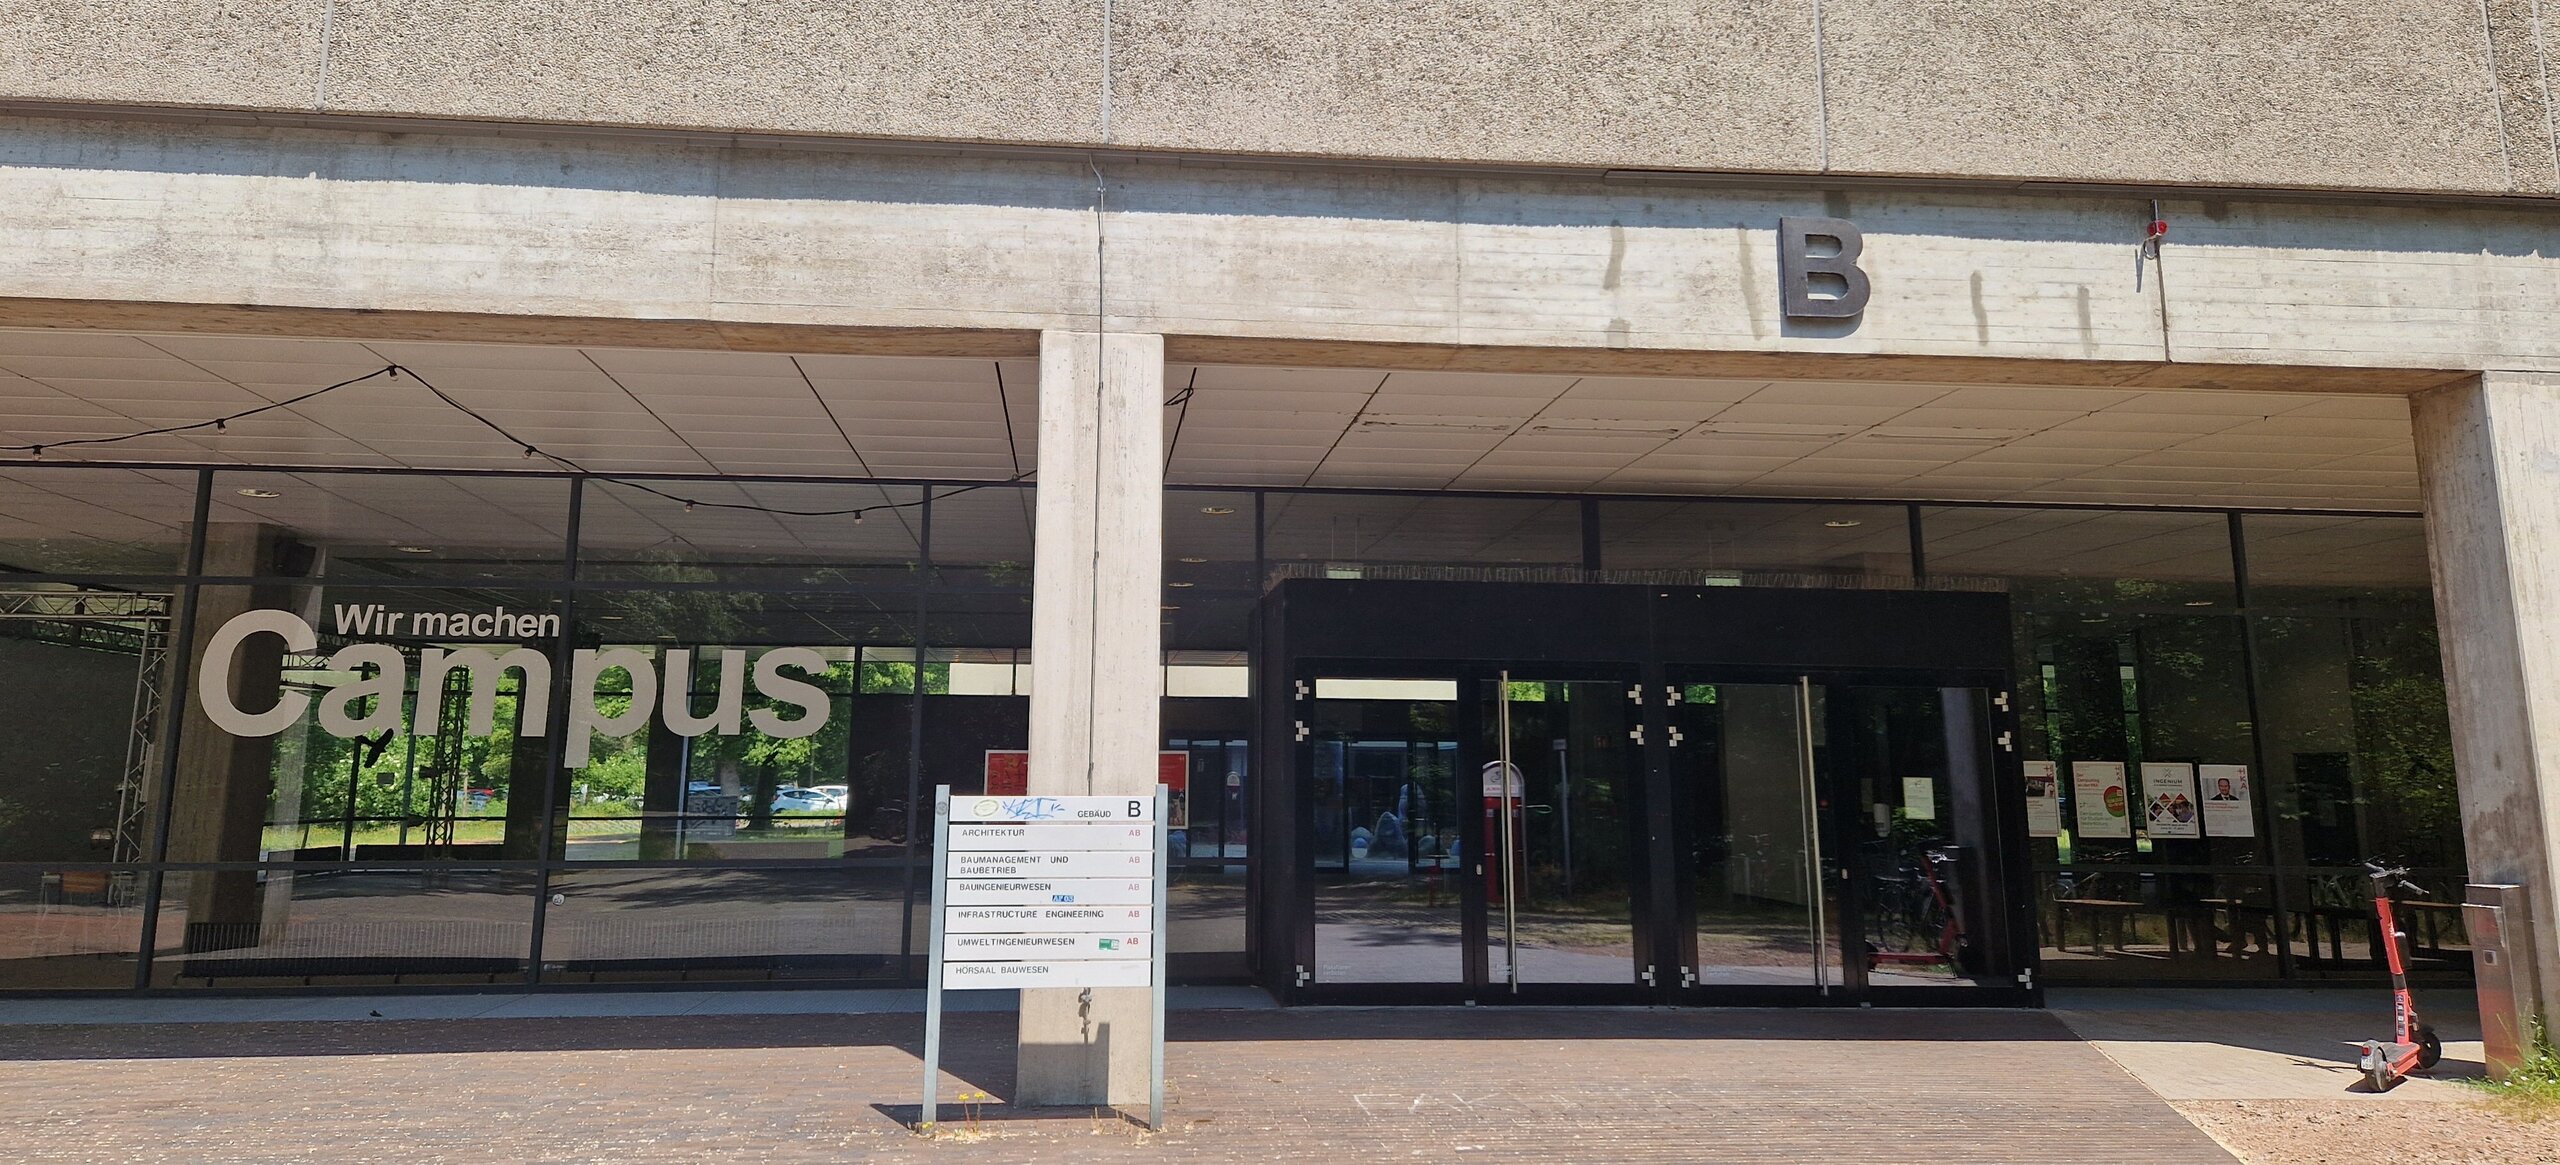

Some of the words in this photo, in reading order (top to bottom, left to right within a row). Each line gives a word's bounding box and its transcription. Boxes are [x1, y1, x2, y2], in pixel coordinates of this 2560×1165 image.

[1780, 216, 1871, 318] B
[334, 604, 403, 636] Wir
[412, 606, 560, 638] machen
[198, 609, 831, 768] Campus
[1077, 809, 1112, 818] GEBÄUD
[1127, 800, 1142, 818] B
[961, 829, 1025, 837] ARCHITEKTUR
[1128, 829, 1141, 837] AB
[960, 855, 1041, 864] BAUMANAGEMENT
[1050, 856, 1069, 864] UND
[1128, 856, 1141, 864] AB
[960, 866, 1017, 875] BAUBETRIEB
[959, 882, 1051, 891] BAUINGENIEURWESEN
[1127, 883, 1140, 891] AB
[958, 910, 1037, 919] INFRASTRUCTURE
[1045, 910, 1104, 919] ENGINEERING
[1127, 910, 1140, 918] AB
[957, 937, 1075, 946] UMWELTINGENIEURWESEN
[1126, 937, 1139, 945] AB
[955, 965, 996, 975] HÖRSAAL
[1000, 966, 1049, 974] BAUWESEN
